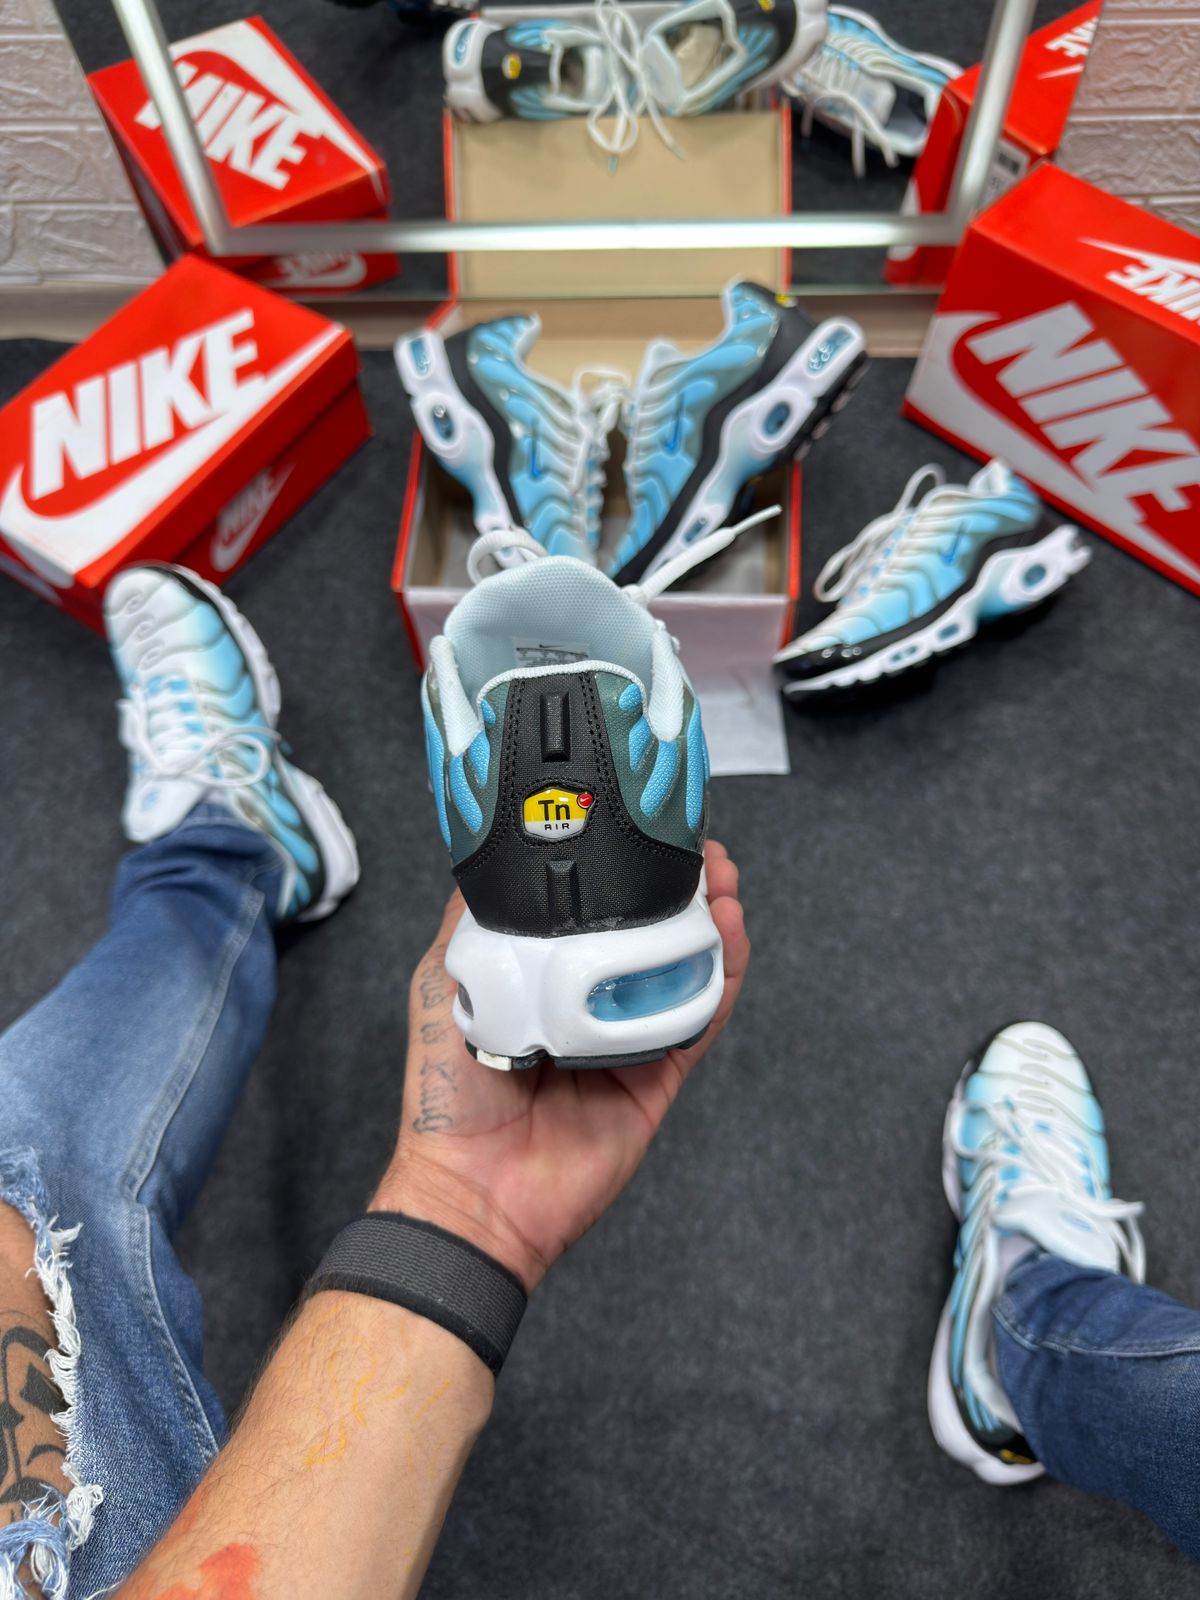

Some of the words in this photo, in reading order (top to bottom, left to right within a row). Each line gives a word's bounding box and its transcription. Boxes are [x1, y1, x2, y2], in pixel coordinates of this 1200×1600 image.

[31, 307, 267, 501] NIKE
[965, 300, 1200, 526] NIKE
[537, 799, 571, 822] Tn
[544, 822, 570, 831] AIR
